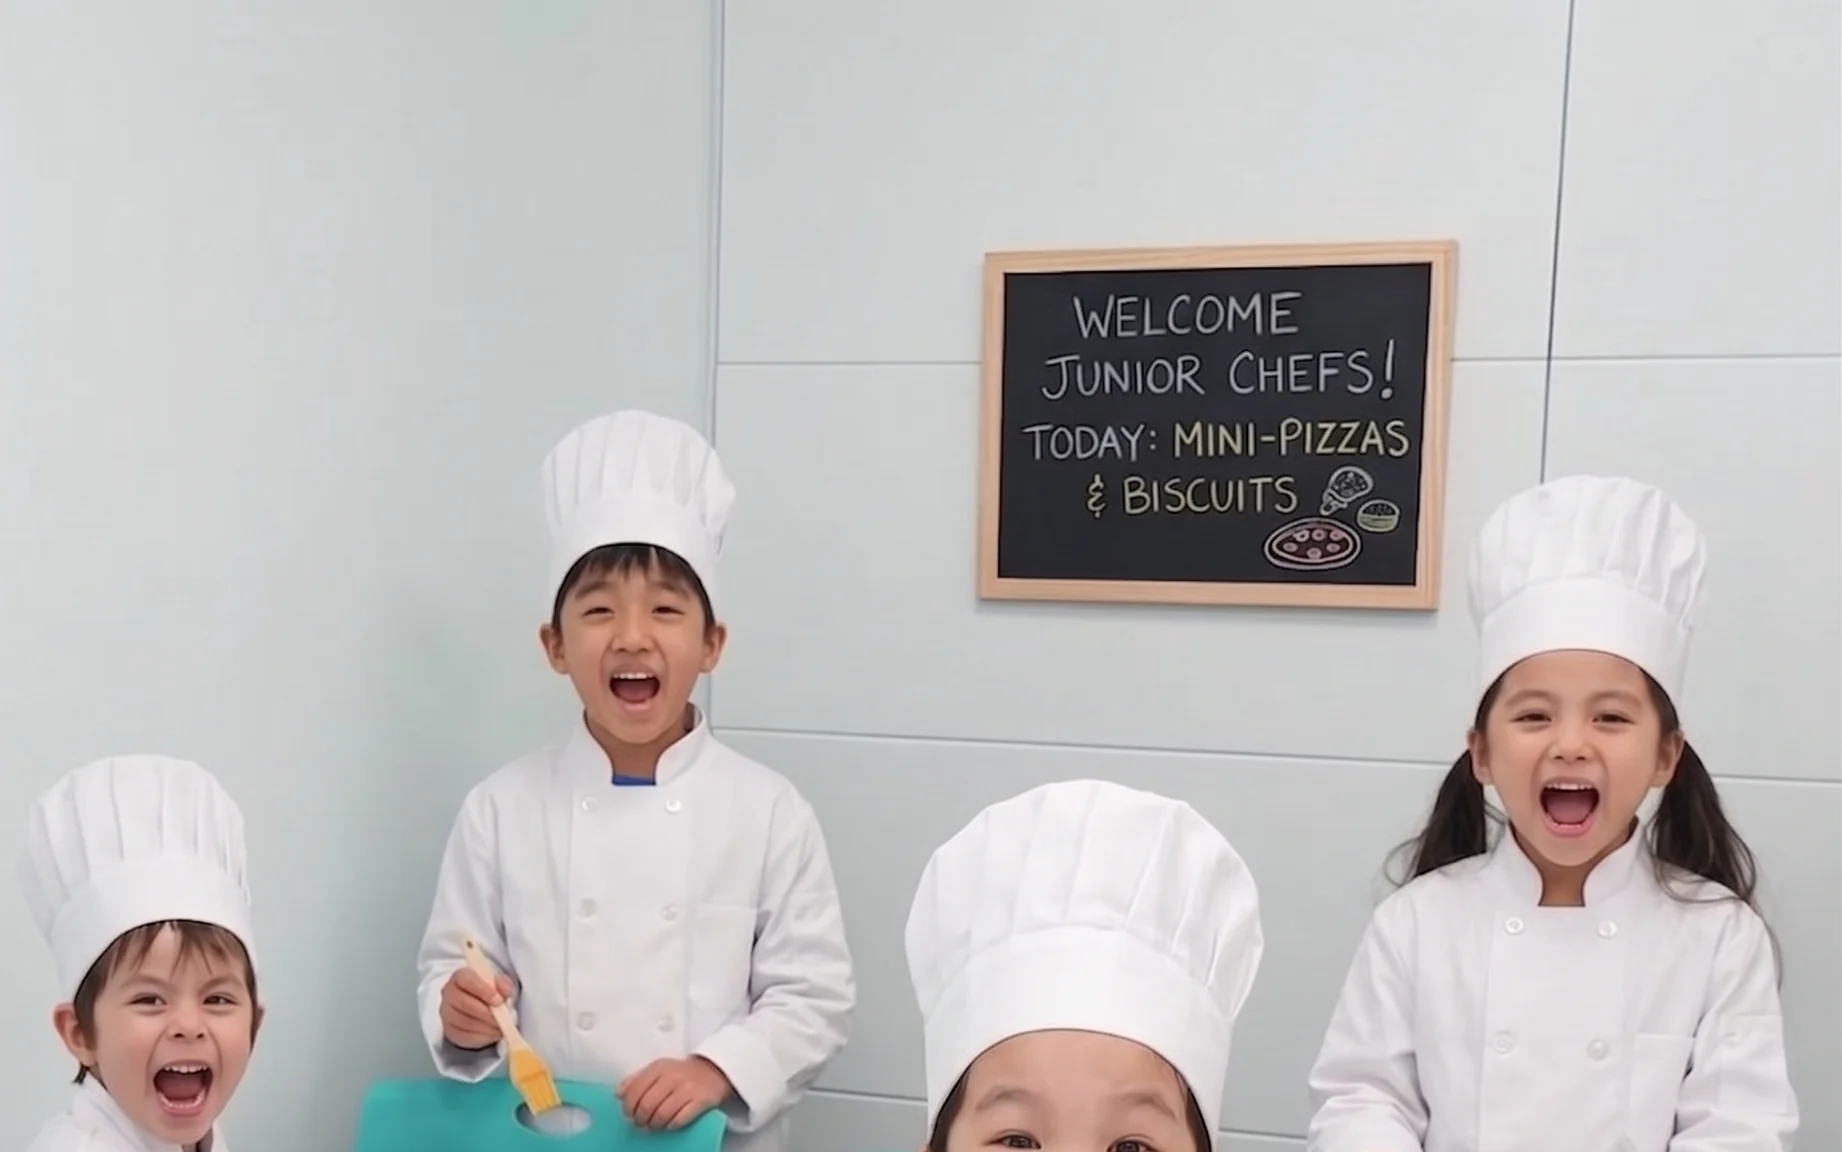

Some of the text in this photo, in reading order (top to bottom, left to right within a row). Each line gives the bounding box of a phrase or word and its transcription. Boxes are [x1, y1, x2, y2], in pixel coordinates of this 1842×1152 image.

[1073, 291, 1302, 339] WELCOME
[1041, 338, 1396, 400] JUNIOR CHEFS!
[1022, 417, 1409, 462] TODAY: MINI-PIZZAS
[1087, 473, 1298, 517] & BISCUITS
